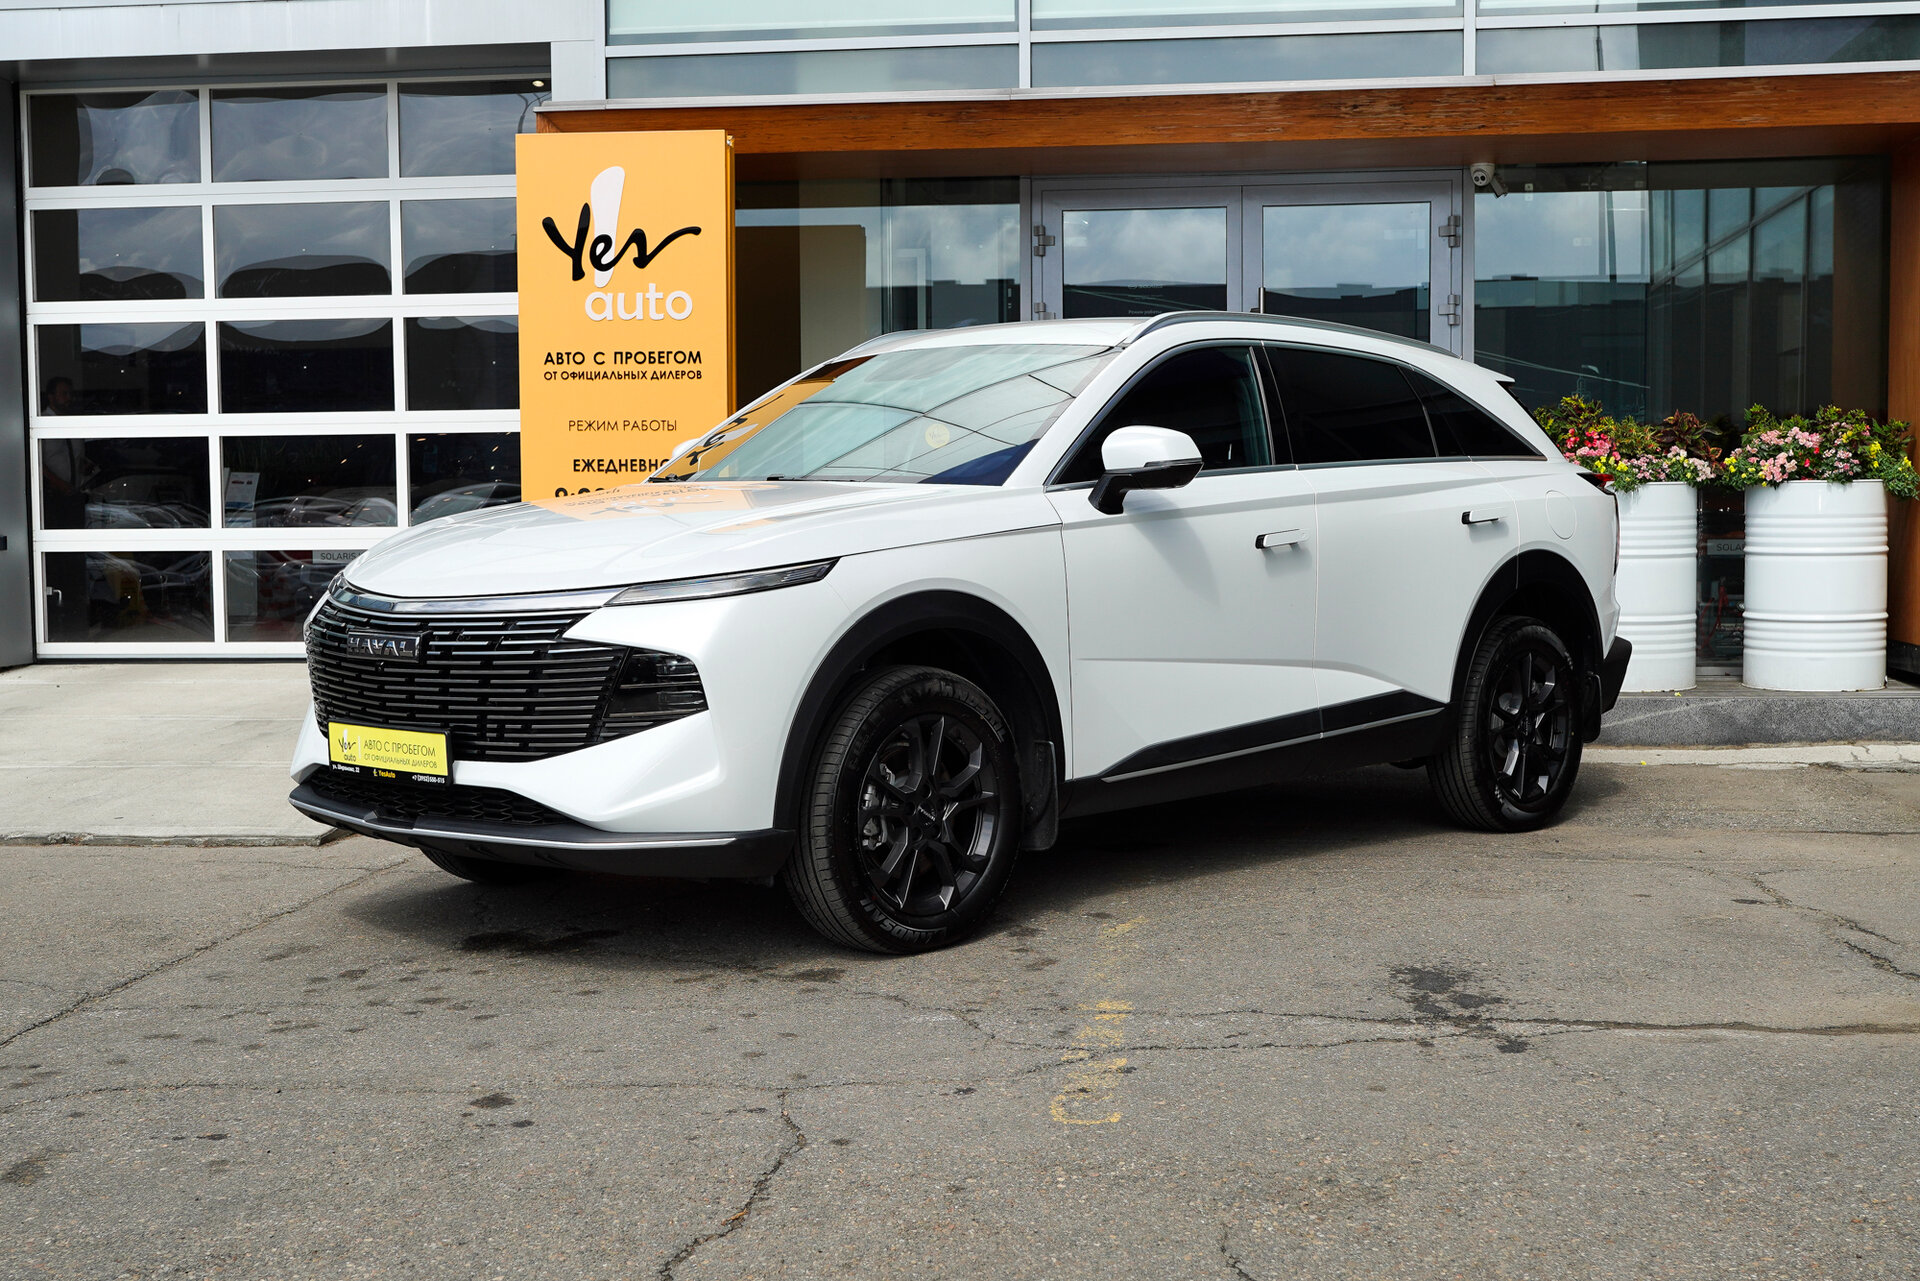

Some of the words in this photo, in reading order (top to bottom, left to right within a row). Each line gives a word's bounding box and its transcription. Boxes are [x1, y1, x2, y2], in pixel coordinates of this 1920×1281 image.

[542, 203, 702, 281] Yes
[585, 283, 693, 321] auto
[544, 352, 586, 365] АВТО
[593, 352, 606, 365] С
[614, 351, 702, 365] ПРОБЕГОМ
[544, 371, 557, 380] ОТ
[561, 370, 648, 381] ОФИЦИАЛЬНЫХ
[650, 370, 702, 381] ДИЛЕРОВ
[568, 420, 619, 432] РЕЖИМ
[623, 419, 677, 432] РАБОТЫ
[1716, 543, 1745, 552] SOLA
[320, 552, 357, 561] SOLARIS
[348, 637, 415, 657] HAVAL
[363, 740, 382, 752] АВТО
[384, 742, 391, 753] С
[392, 742, 436, 757] ПРОБЕГОМ
[344, 754, 356, 763] auto
[363, 753, 371, 761] ОТ
[371, 754, 411, 766] ОФИЦИАЛЬНЫХ
[412, 758, 438, 769] ДИЛЕРОВ
